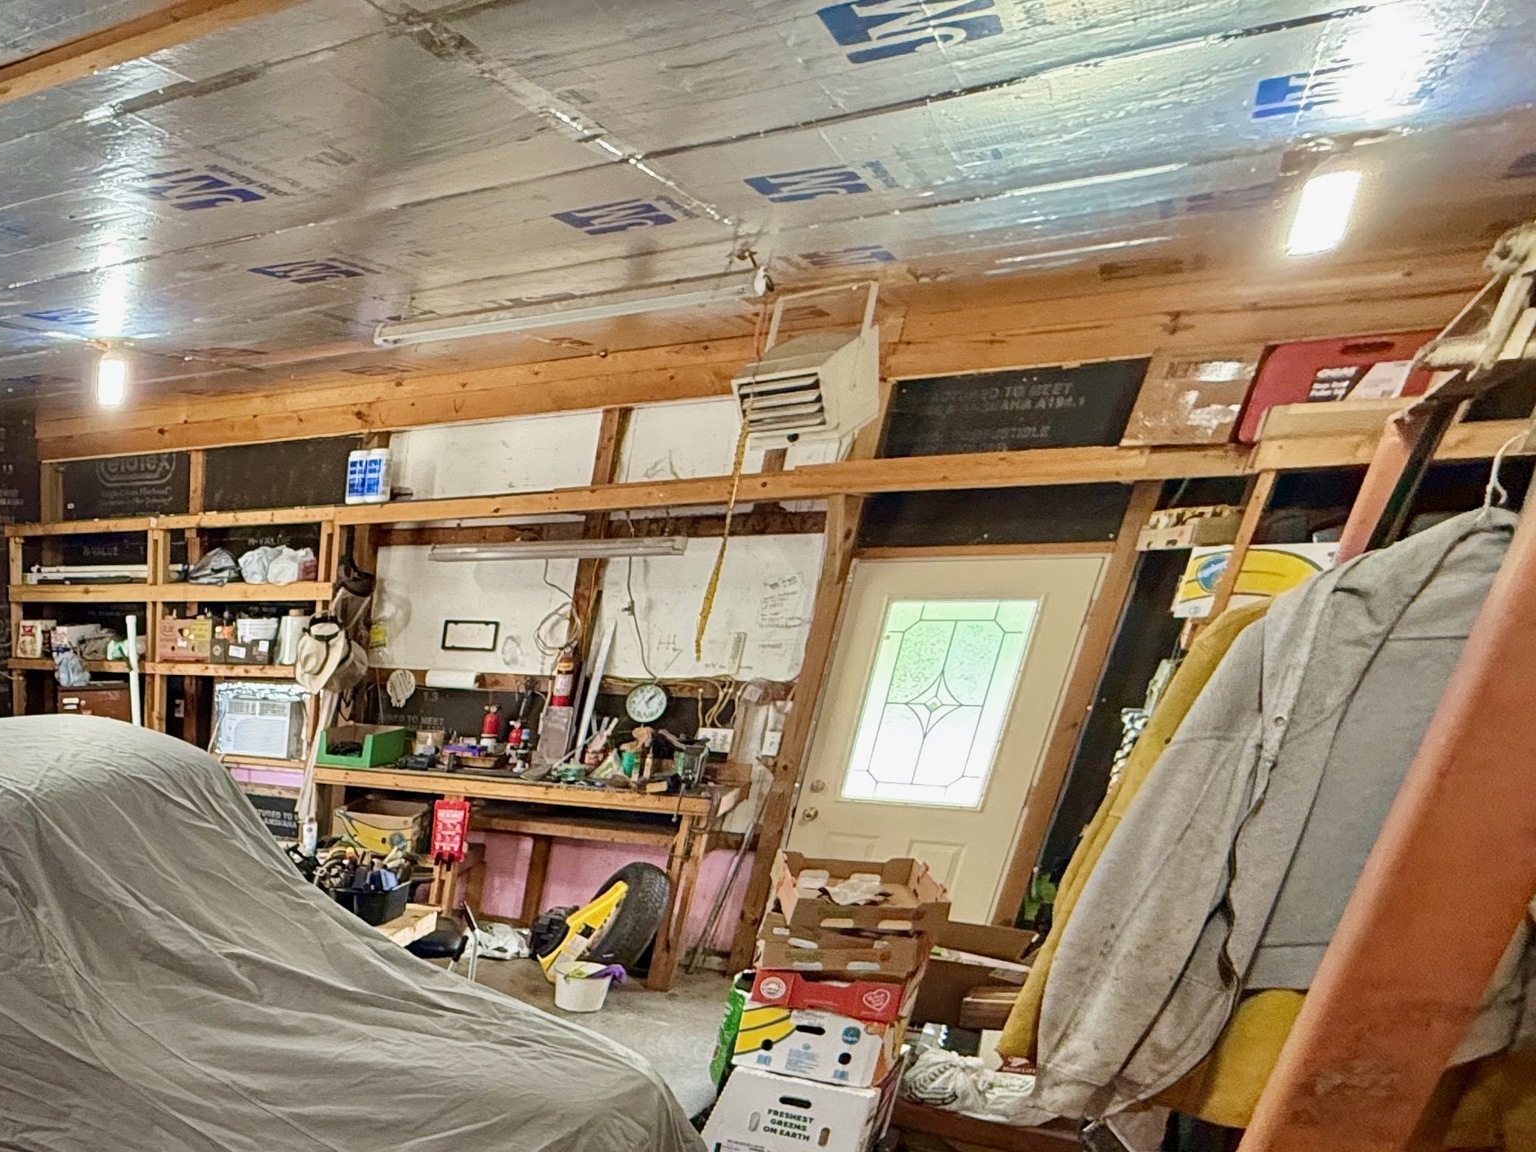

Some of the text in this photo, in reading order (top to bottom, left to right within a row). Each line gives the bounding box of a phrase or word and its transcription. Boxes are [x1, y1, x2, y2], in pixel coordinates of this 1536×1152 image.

[767, 1108, 815, 1124] FRESHEST
[770, 1118, 807, 1132] GREENS
[763, 1125, 810, 1142] ON EARTH
